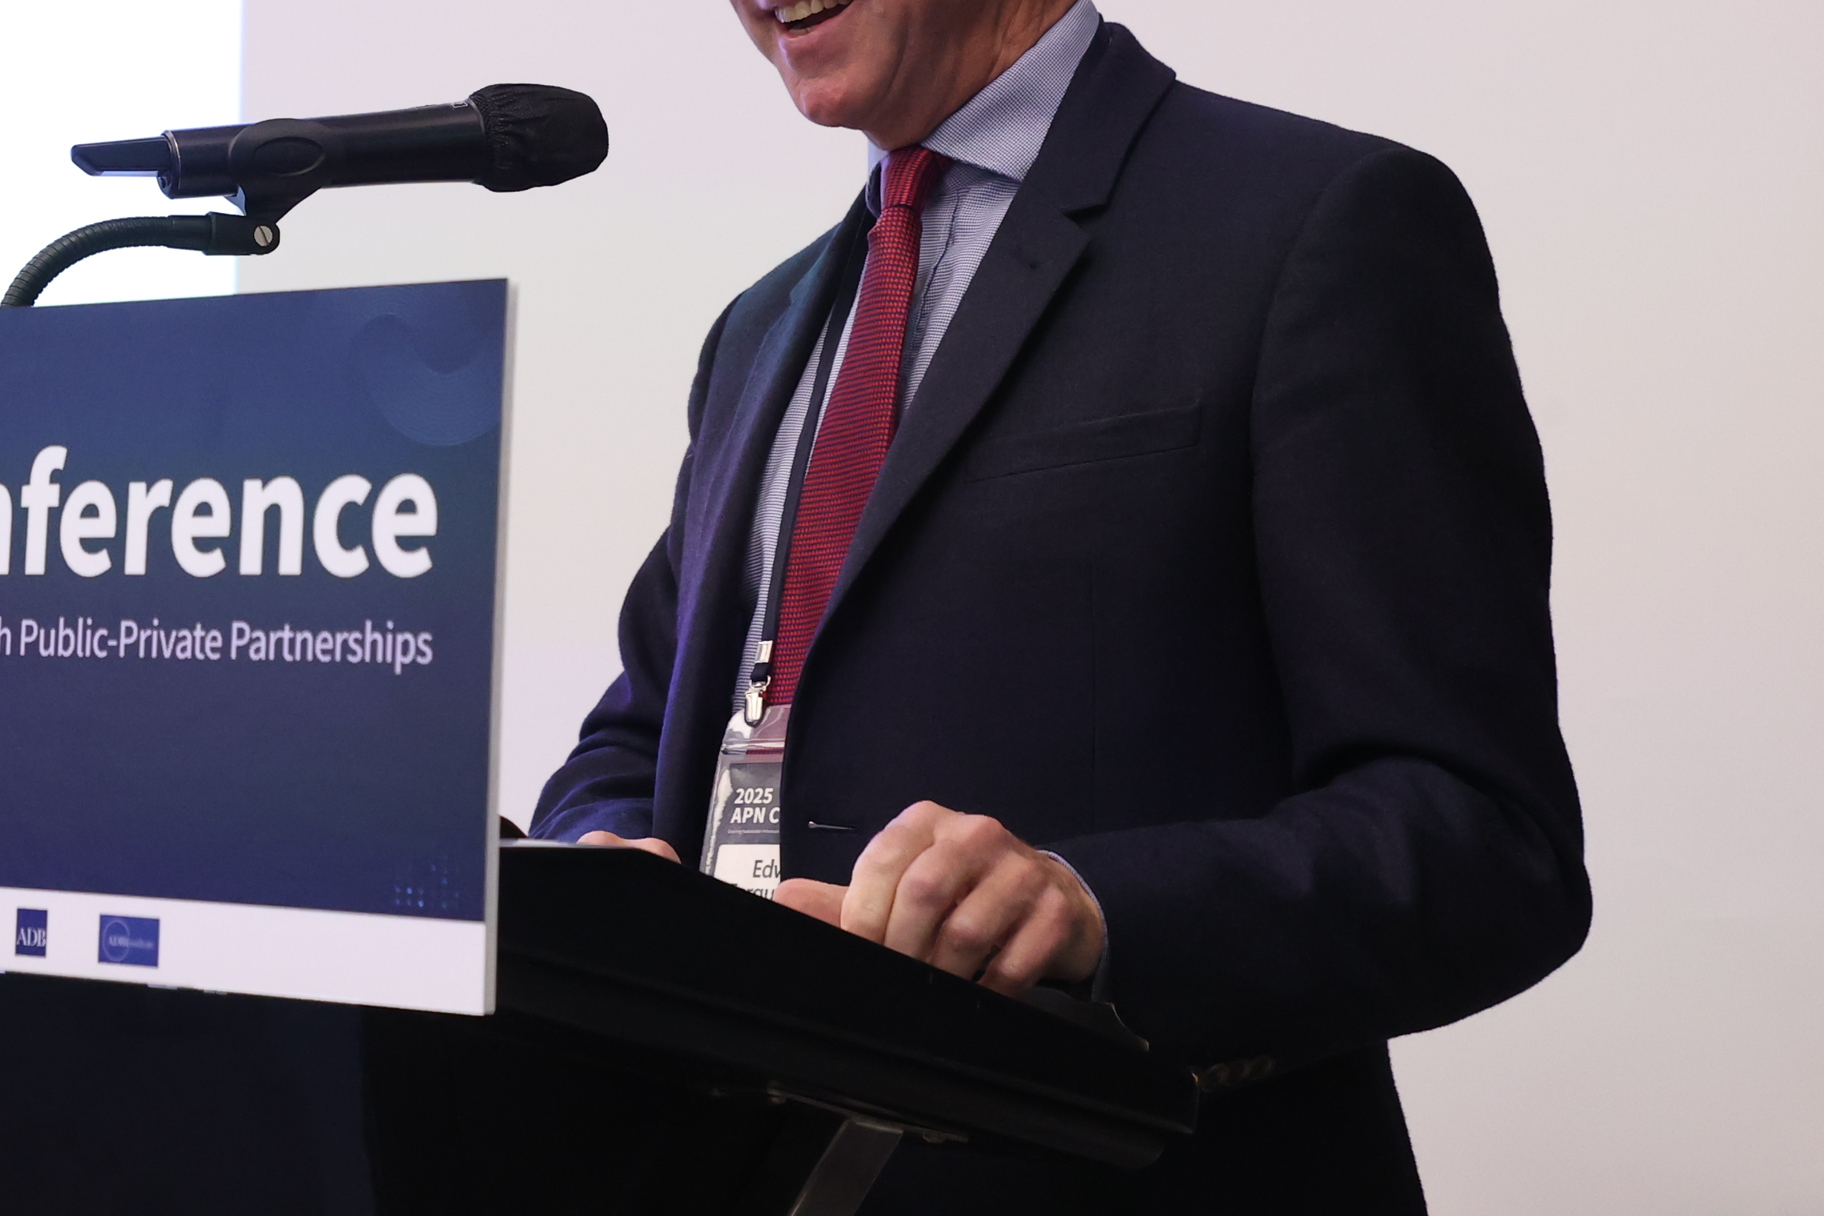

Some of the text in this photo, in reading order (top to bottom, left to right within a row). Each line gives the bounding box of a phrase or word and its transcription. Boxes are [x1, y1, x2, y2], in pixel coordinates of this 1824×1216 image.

[20, 617, 222, 661] Public-Private
[230, 620, 433, 675] Partnerships
[734, 788, 773, 804] 2025
[730, 807, 766, 823] APN
[16, 927, 46, 947] ADB
